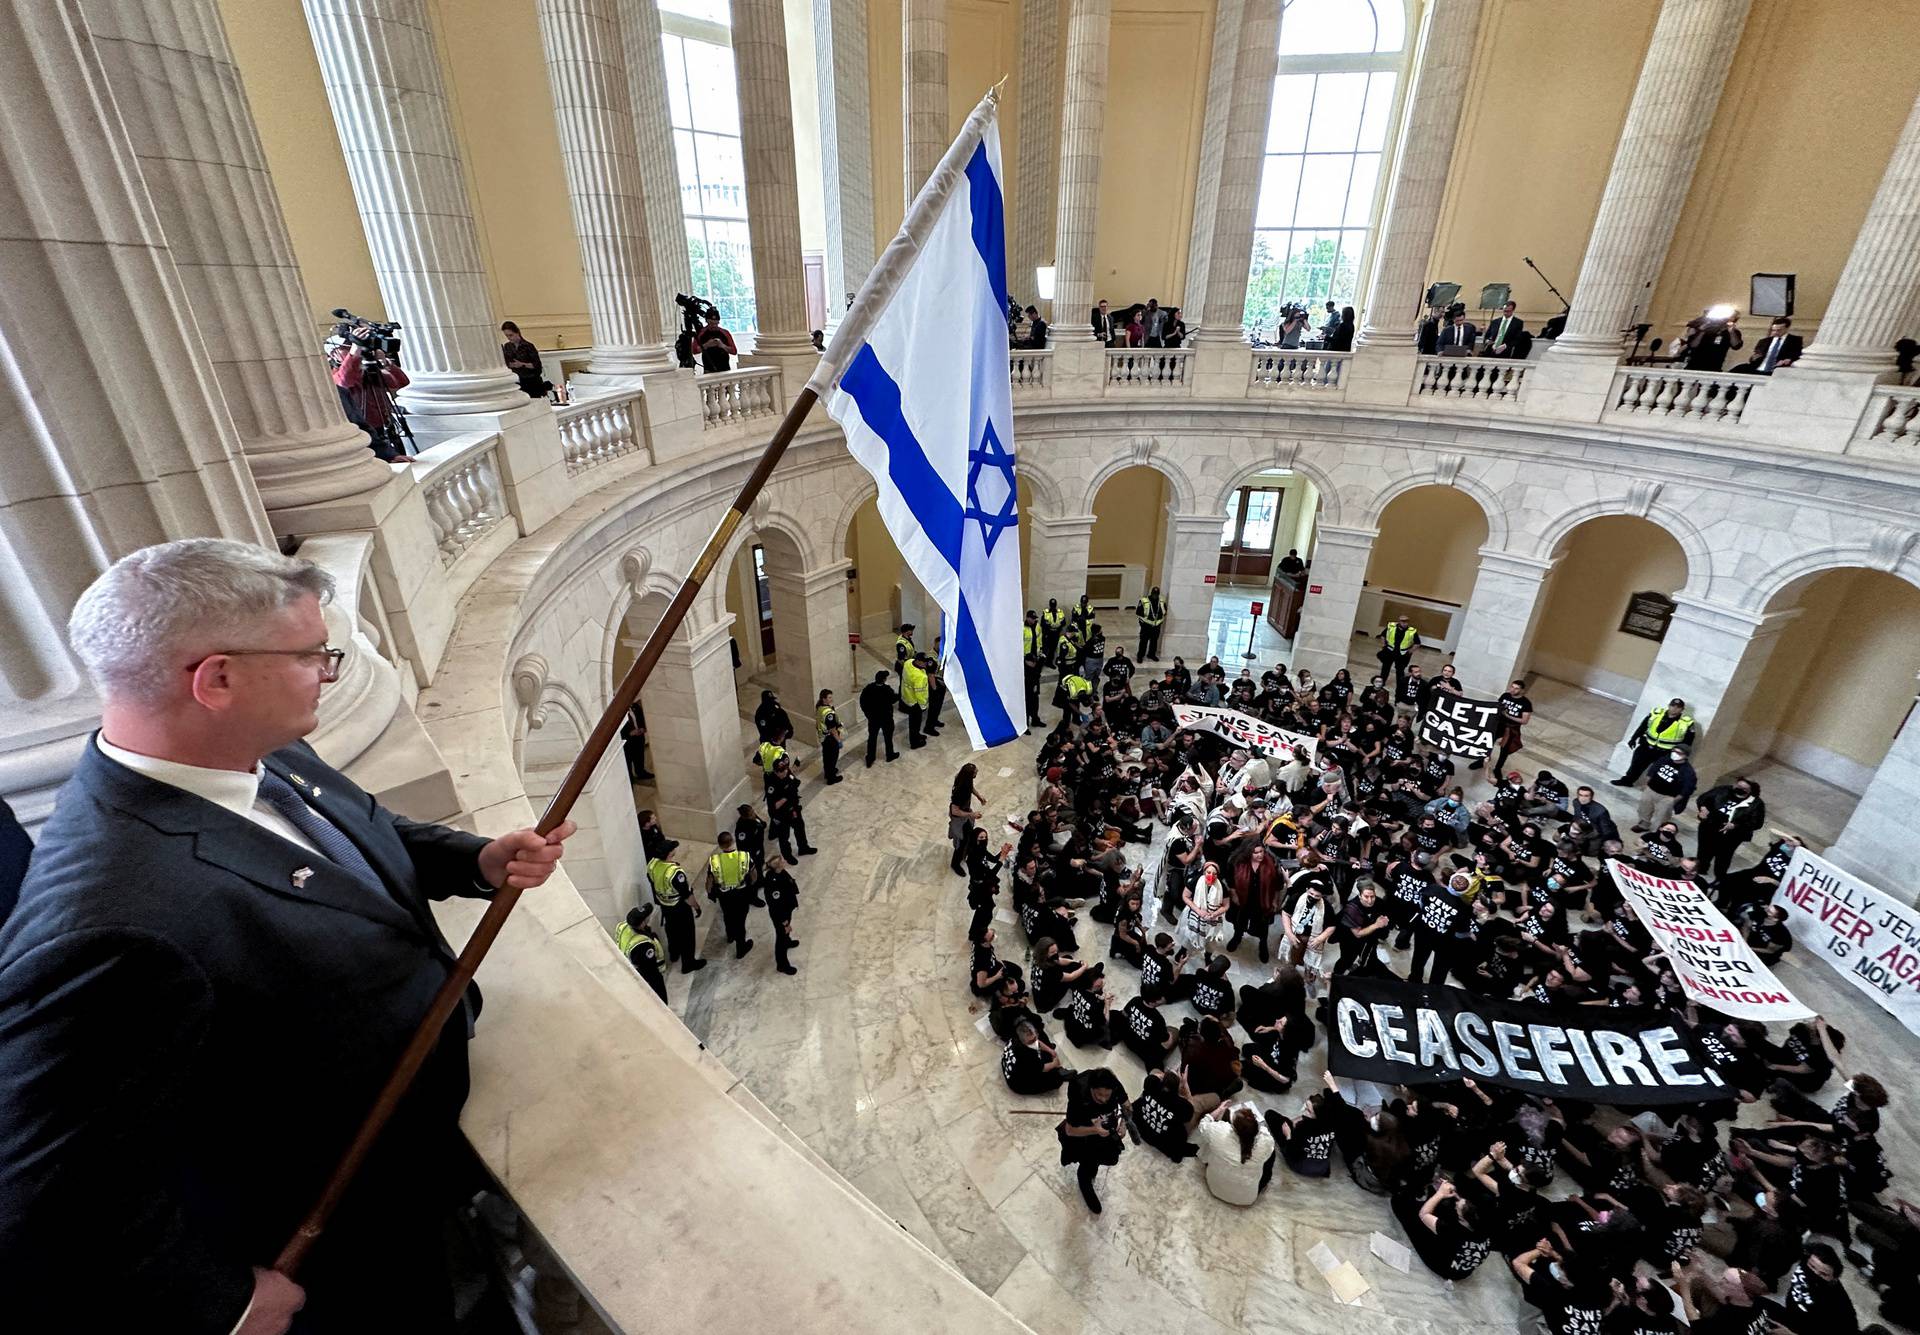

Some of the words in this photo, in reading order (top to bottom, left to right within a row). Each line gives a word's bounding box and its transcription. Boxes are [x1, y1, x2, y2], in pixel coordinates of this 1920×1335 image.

[1436, 697, 1498, 727] LET
[1256, 724, 1298, 744] SAY
[1426, 711, 1493, 748] GAZA
[1400, 874, 1428, 888] JEWS
[1616, 863, 1696, 892] LIVING
[1429, 896, 1458, 916] JEWS
[1662, 891, 1706, 903] FOR
[1429, 902, 1450, 918] SAY
[1652, 909, 1712, 926] LIKE
[1784, 876, 1874, 948] NEVER
[1800, 862, 1876, 914] PHILLY
[1879, 910, 1920, 954] JEW
[1652, 917, 1735, 943] FIGHT
[1678, 938, 1721, 956] AND
[1828, 935, 1851, 958] IS
[1677, 950, 1754, 973] DEAD
[1700, 972, 1748, 988] THE
[1855, 956, 1902, 995] NOW
[1681, 973, 1790, 1004] MOURN
[1130, 1006, 1153, 1026] JEWS
[1701, 1038, 1725, 1060] OUR
[1145, 1095, 1174, 1120] JEWS
[1146, 1104, 1167, 1124] SAY
[1306, 1132, 1335, 1144] JEWS
[1519, 1145, 1558, 1156] JEWS
[1524, 1154, 1552, 1164] SAY
[1564, 1304, 1602, 1322] JEWS
[1570, 1317, 1600, 1334] SAY
